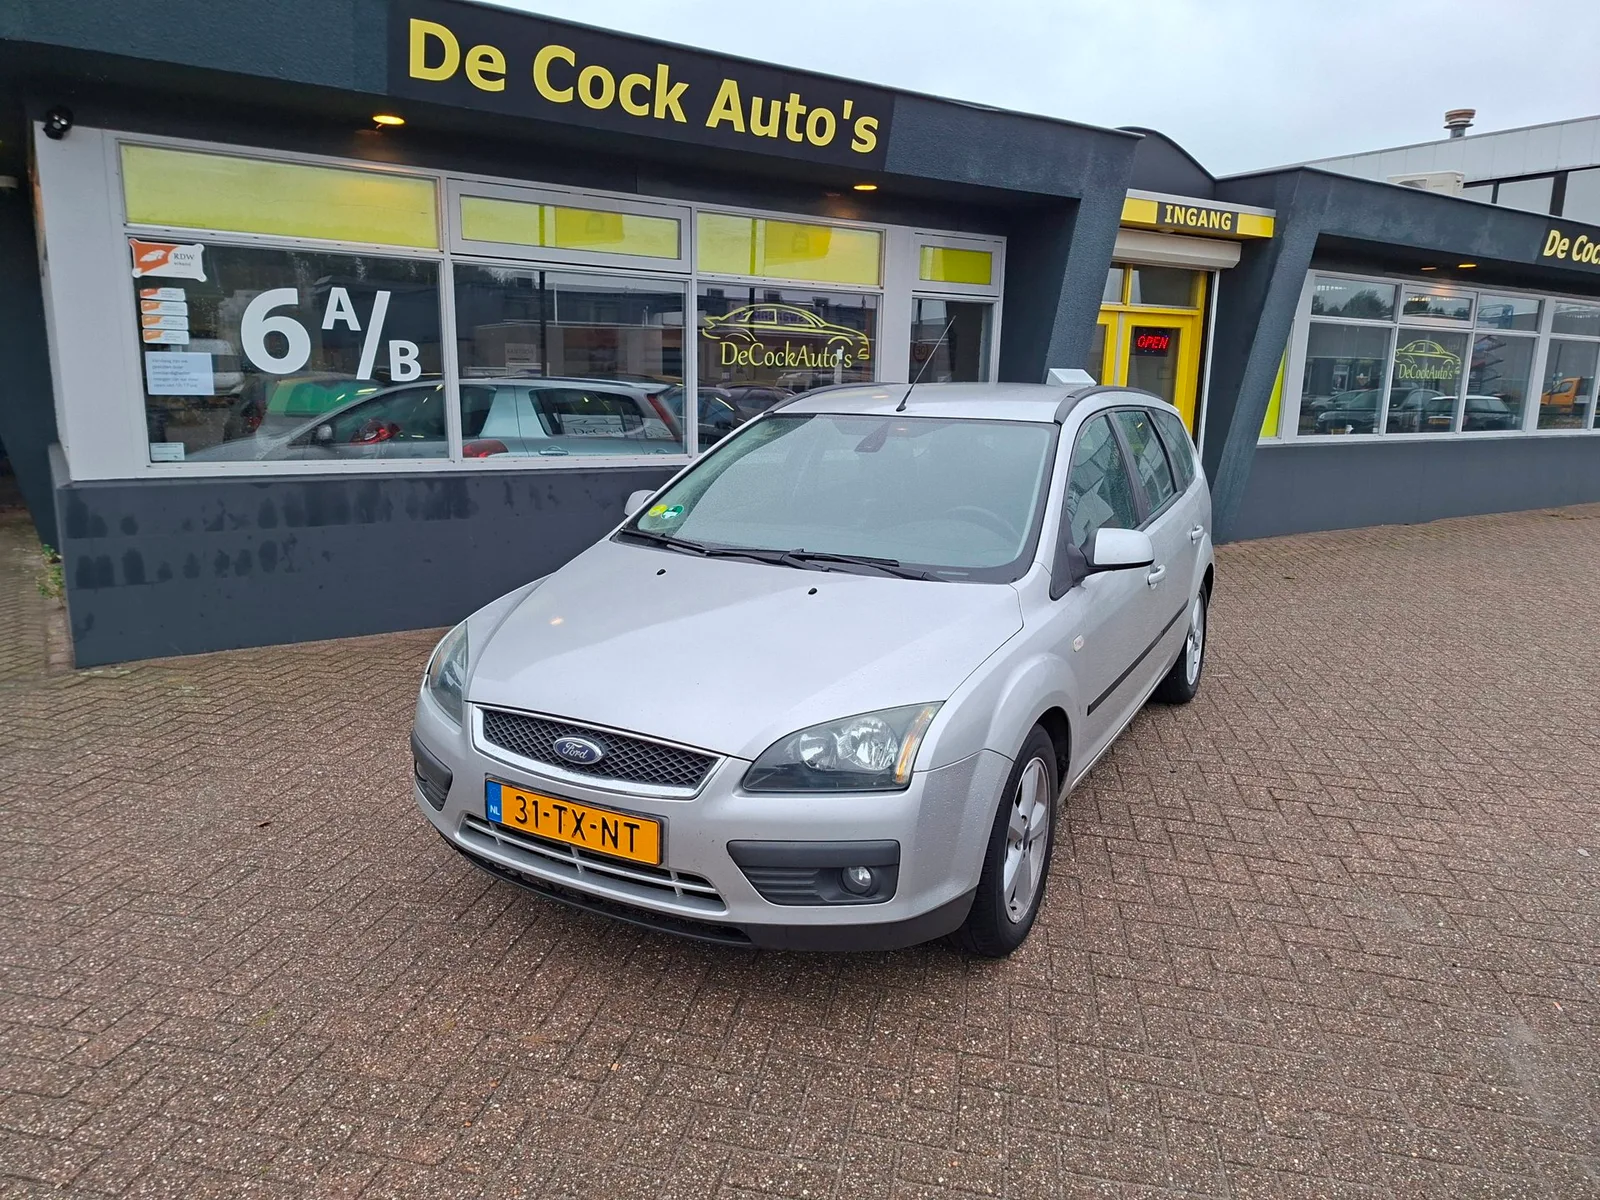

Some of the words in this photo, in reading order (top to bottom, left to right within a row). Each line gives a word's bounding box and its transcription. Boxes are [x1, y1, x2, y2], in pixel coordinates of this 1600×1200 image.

[409, 18, 506, 91] De
[533, 44, 689, 123] Cock
[706, 79, 879, 153] Auto's
[1164, 204, 1232, 230] INGANG
[173, 252, 195, 260] RDW
[1543, 229, 1570, 259] De
[1571, 235, 1600, 264] Coc
[240, 287, 311, 374] 6
[1137, 335, 1169, 349] OPEN
[720, 340, 852, 368] DeCockAuto's
[1398, 363, 1453, 379] DeCockAuto's
[561, 741, 590, 760] Ford
[489, 804, 500, 816] NL
[514, 795, 640, 853] 31-TX-NT
